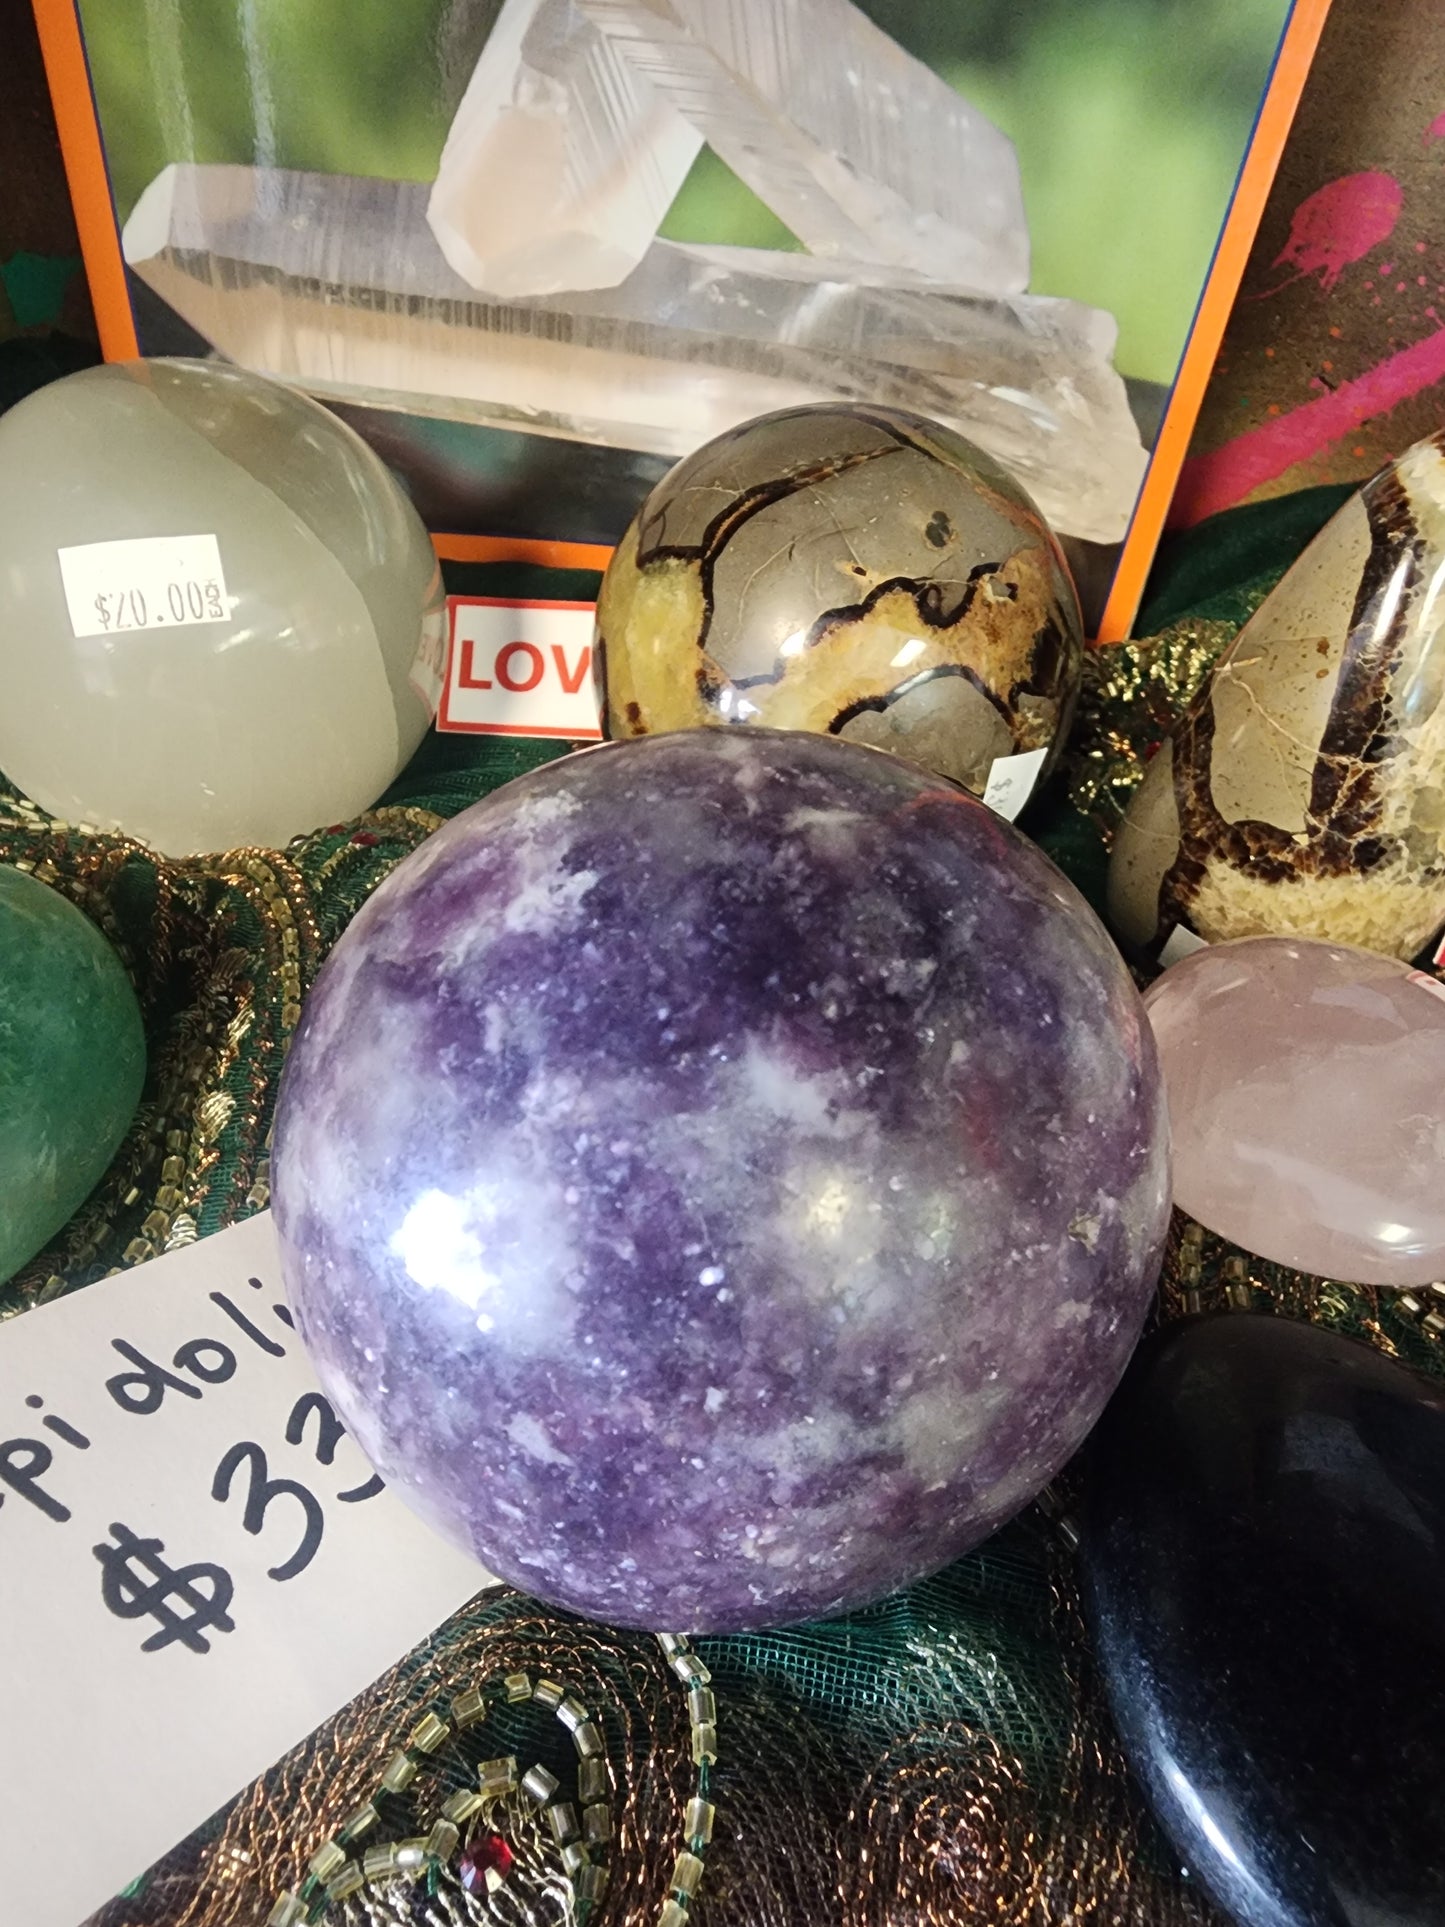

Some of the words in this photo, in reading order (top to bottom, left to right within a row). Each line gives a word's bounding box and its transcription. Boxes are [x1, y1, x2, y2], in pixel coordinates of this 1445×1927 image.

[94, 580, 204, 631] $20.00
[458, 639, 591, 694] LOV
[0, 1277, 296, 1523] pidoli
